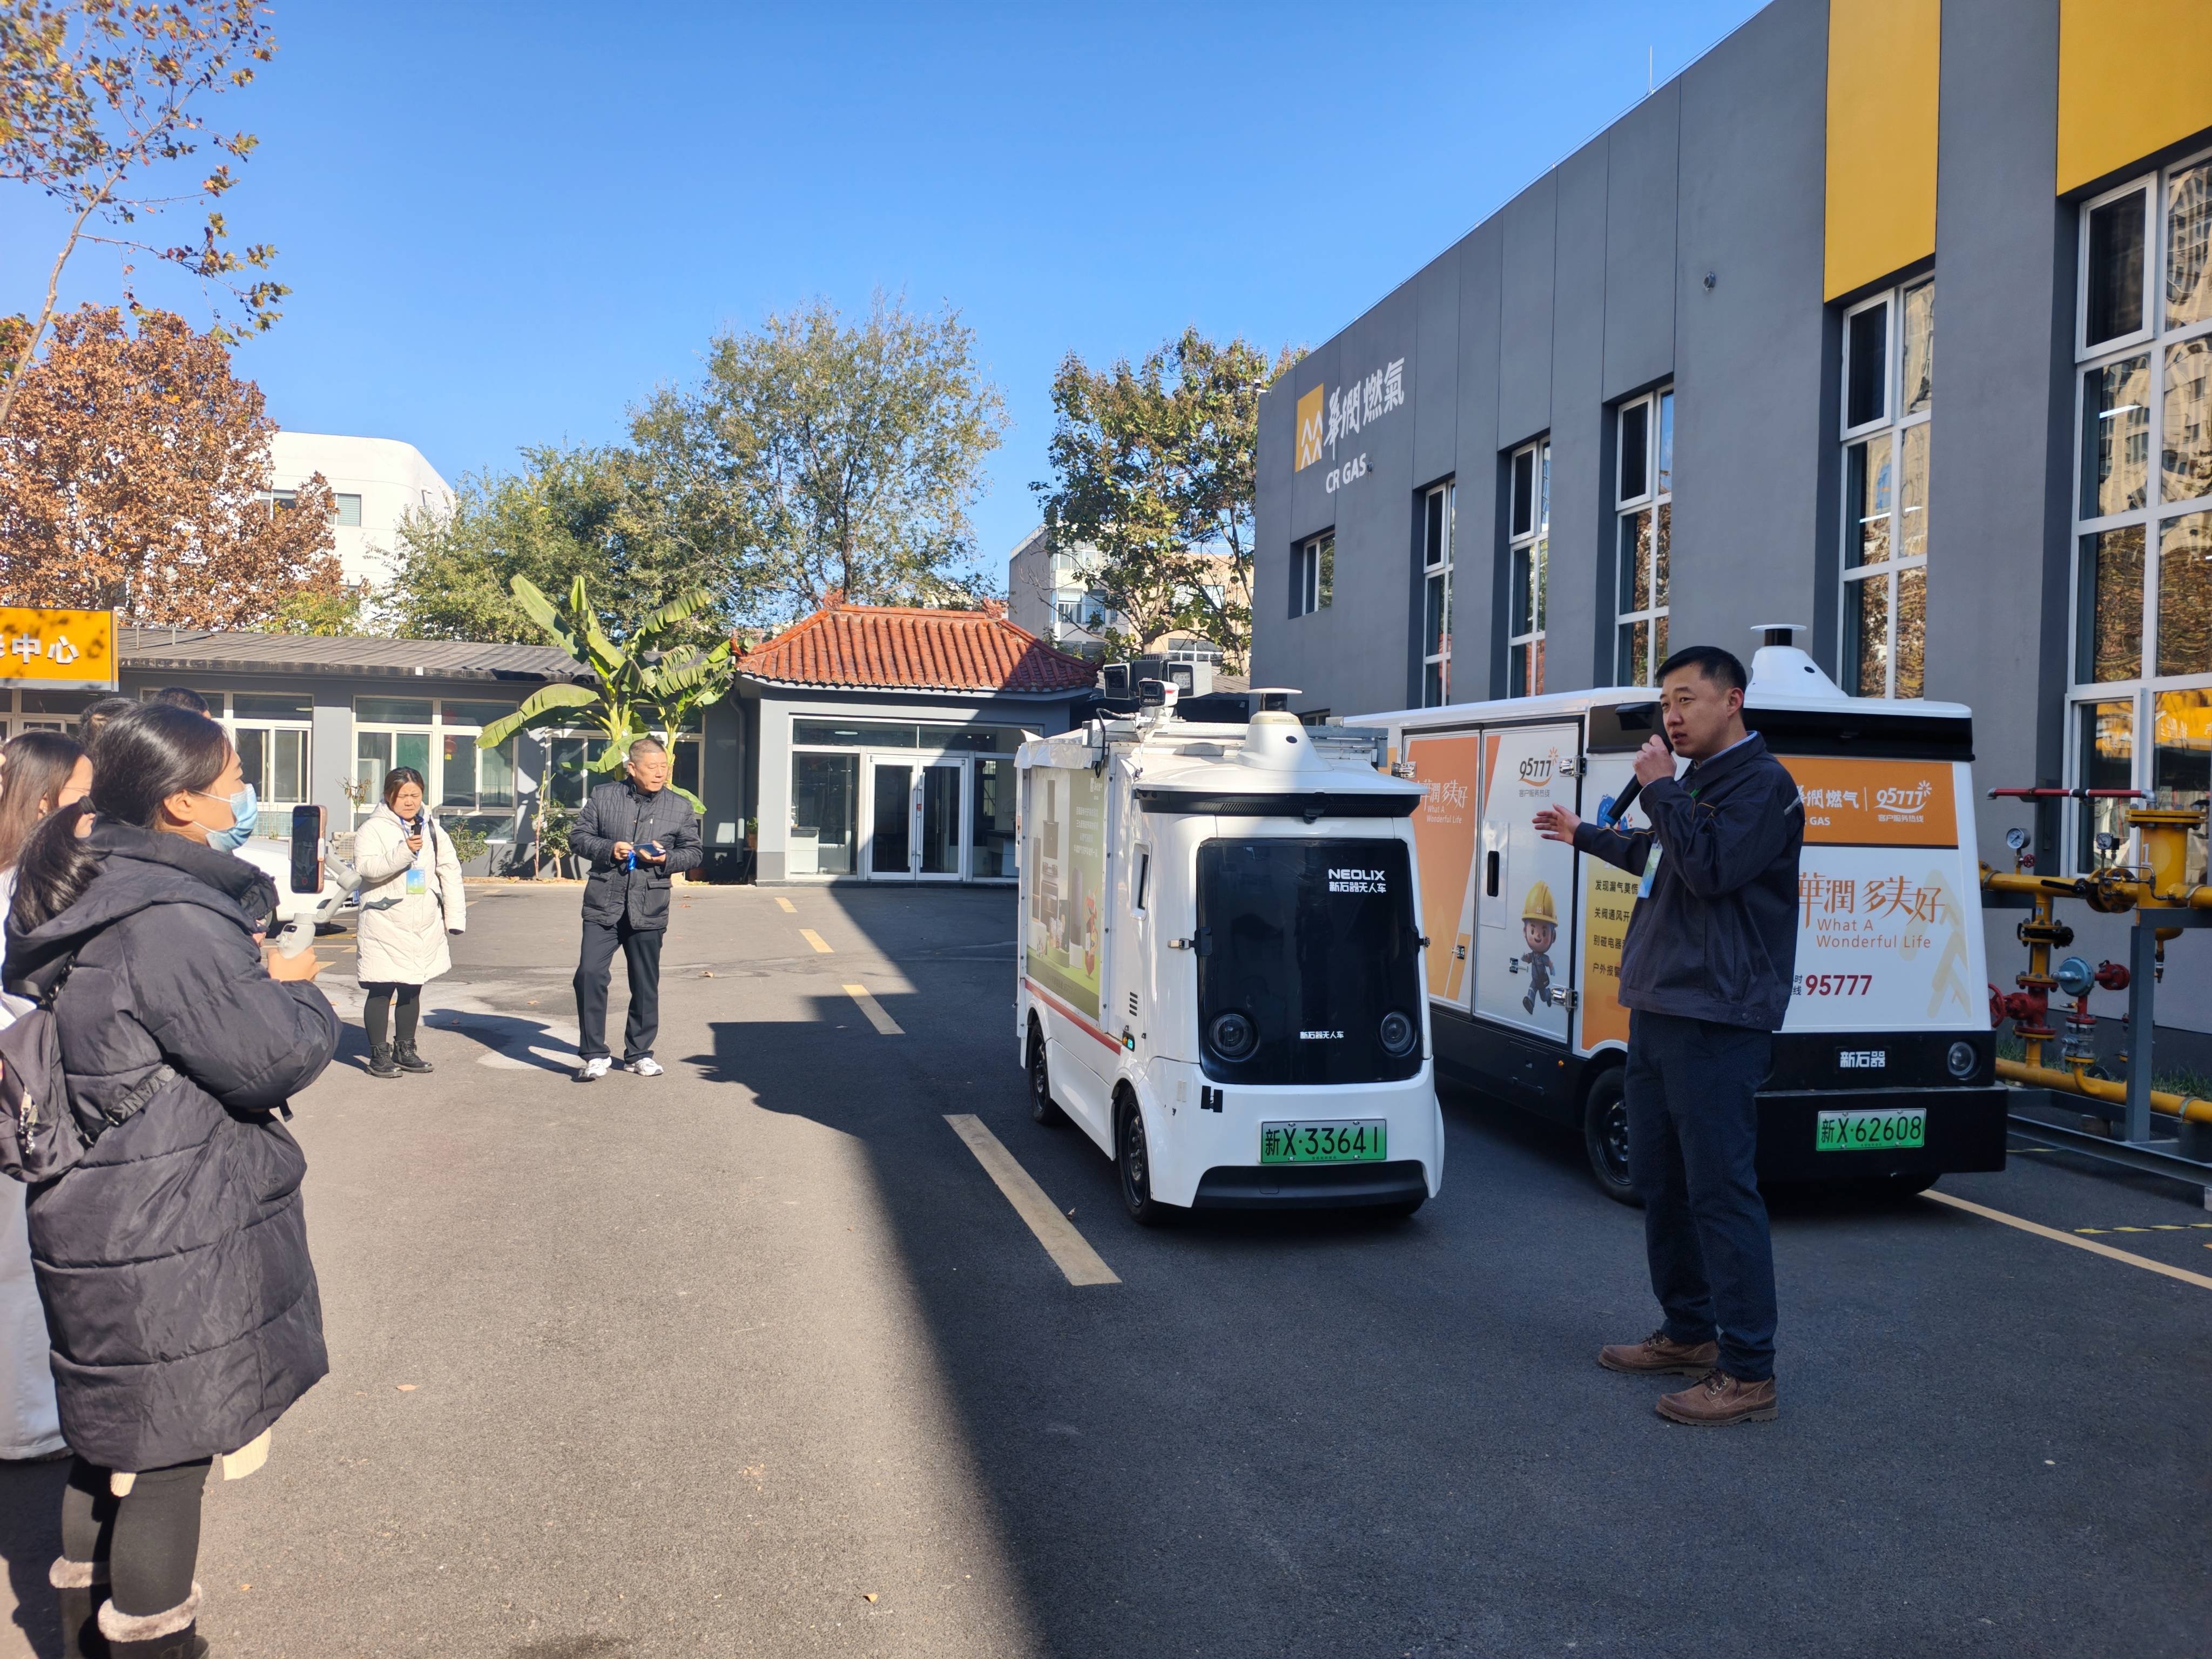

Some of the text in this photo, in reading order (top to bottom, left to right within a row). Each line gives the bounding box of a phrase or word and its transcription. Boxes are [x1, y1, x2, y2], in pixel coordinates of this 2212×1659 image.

[1326, 453, 1366, 494] CR GAS
[0, 633, 80, 664] 中心
[1520, 757, 1552, 779] 95777
[1519, 789, 1550, 798] 客户服务热线
[1876, 787, 1924, 807] 95777
[1427, 805, 1440, 813] What
[1426, 815, 1462, 824] Wonderful Life
[1810, 817, 1831, 826] GAS
[1877, 814, 1925, 822] 客户服务热线
[2141, 843, 2153, 865] 1
[1328, 868, 1386, 881] NEOLIX
[1329, 881, 1386, 893] 新石器无人车
[1595, 879, 1639, 894] 发现漏气莫慌
[1817, 919, 1874, 931] What A
[1816, 935, 1931, 948] Wonderful Life
[1805, 974, 1872, 996] 95777
[1300, 1031, 1344, 1039] 新石器无人车
[1840, 1051, 1885, 1068] 新石器
